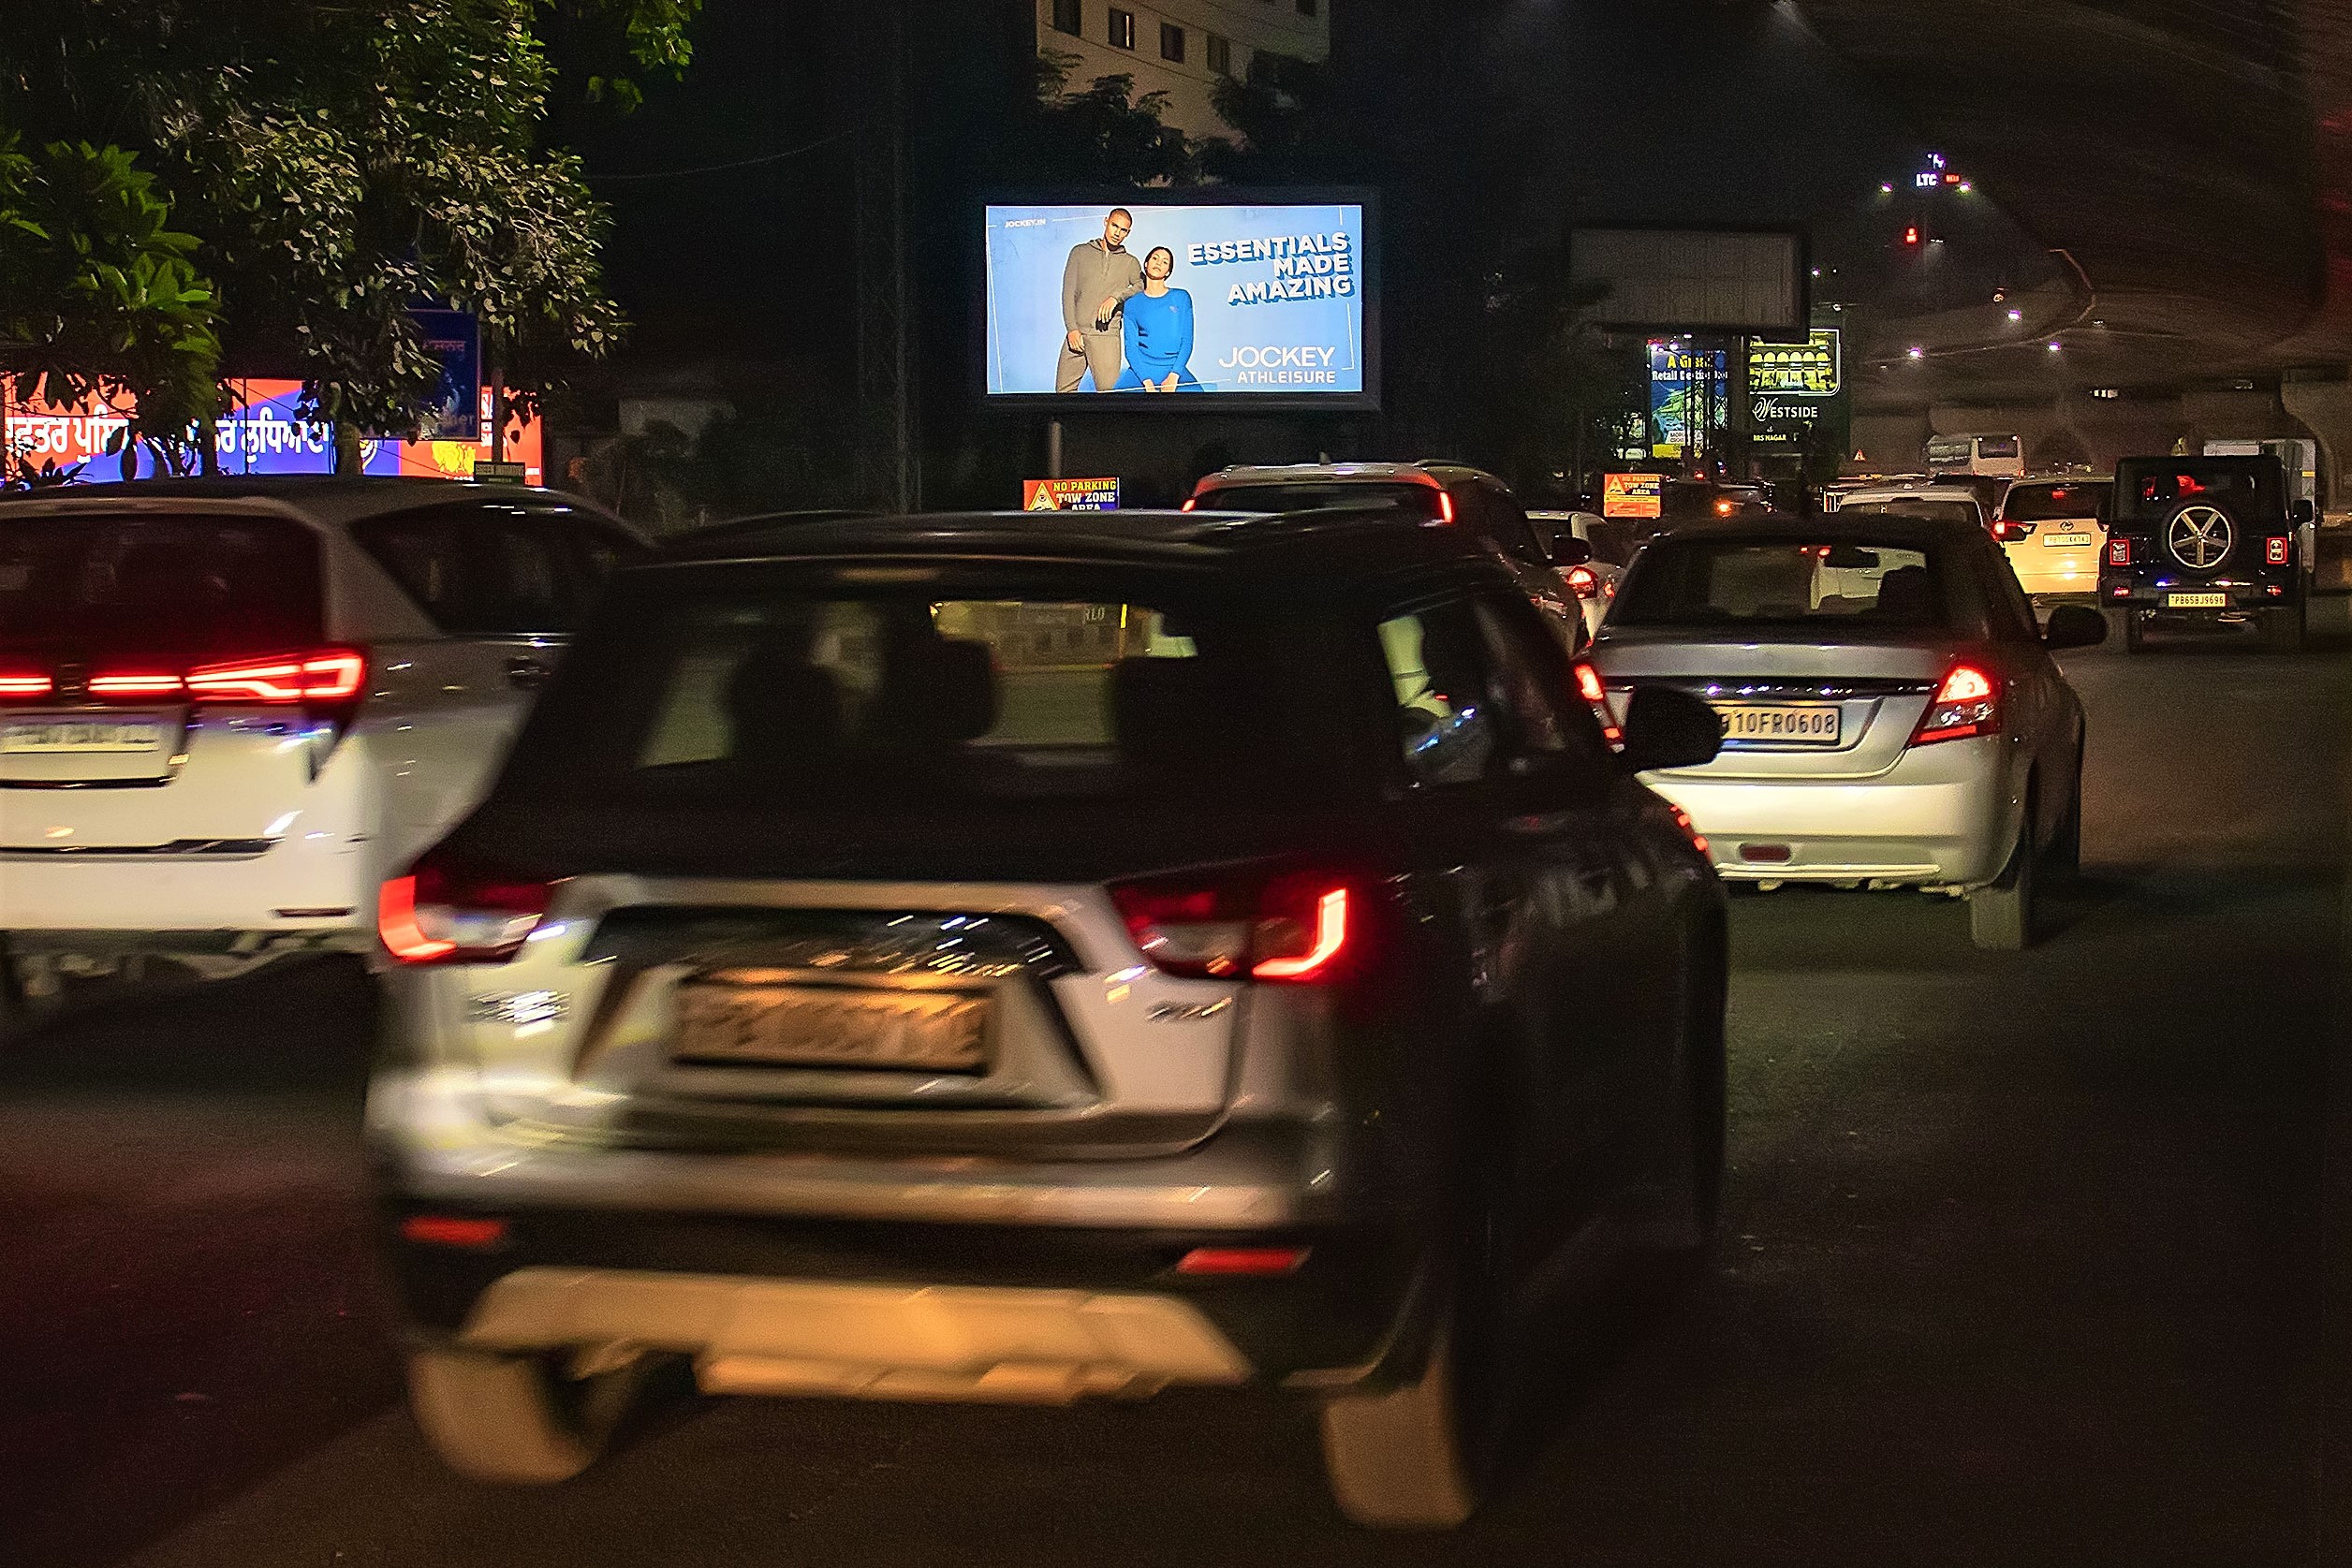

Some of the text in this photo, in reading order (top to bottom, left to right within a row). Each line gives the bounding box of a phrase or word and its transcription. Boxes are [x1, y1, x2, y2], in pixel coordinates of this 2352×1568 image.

[1916, 173, 1937, 186] LTC
[1187, 232, 1351, 266] ESSENTIALS
[1272, 253, 1353, 282] MADE
[1227, 274, 1355, 307] AMAZING
[1218, 346, 1335, 367] JOCKEY
[1237, 371, 1336, 384] ATHLEISURE
[1752, 397, 1818, 422] WESTSIDE
[1053, 481, 1116, 491] NO PARKING
[1056, 491, 1115, 503] TOW ZONE
